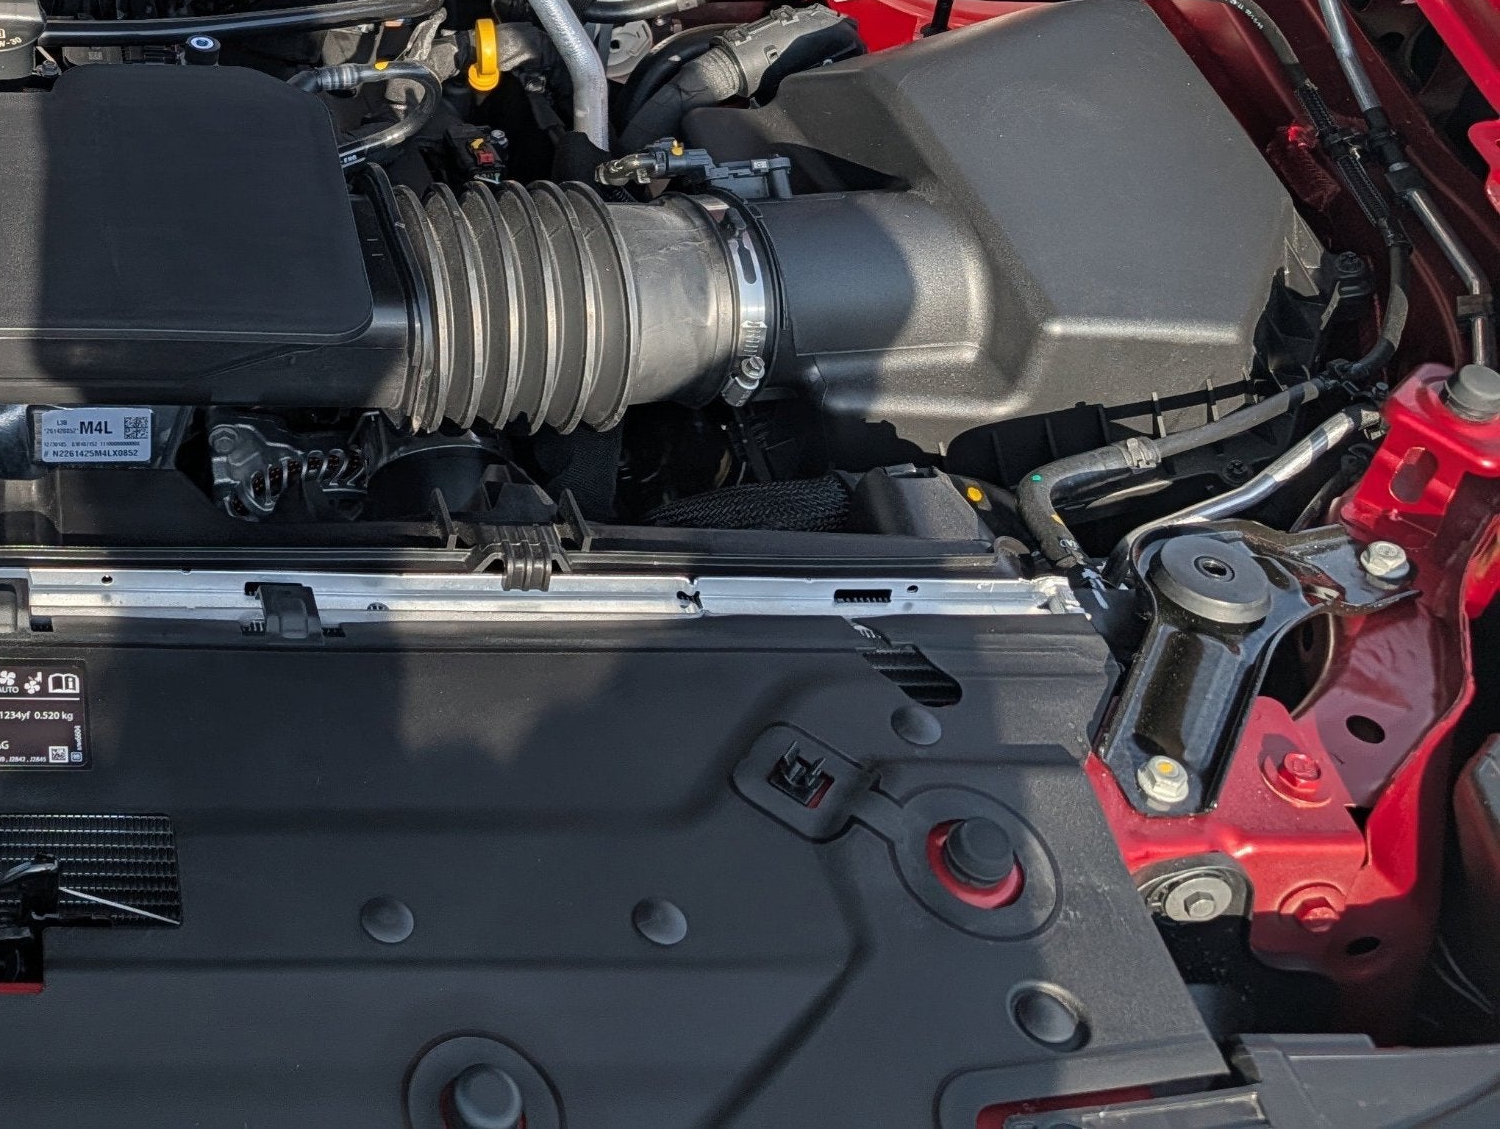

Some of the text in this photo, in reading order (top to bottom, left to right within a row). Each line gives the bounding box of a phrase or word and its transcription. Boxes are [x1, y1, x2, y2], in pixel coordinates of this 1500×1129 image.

[79, 421, 113, 435] M4L
[52, 450, 139, 458] N2261425M4LX0852
[34, 711, 60, 720] 0.520
[61, 711, 74, 721] kg
